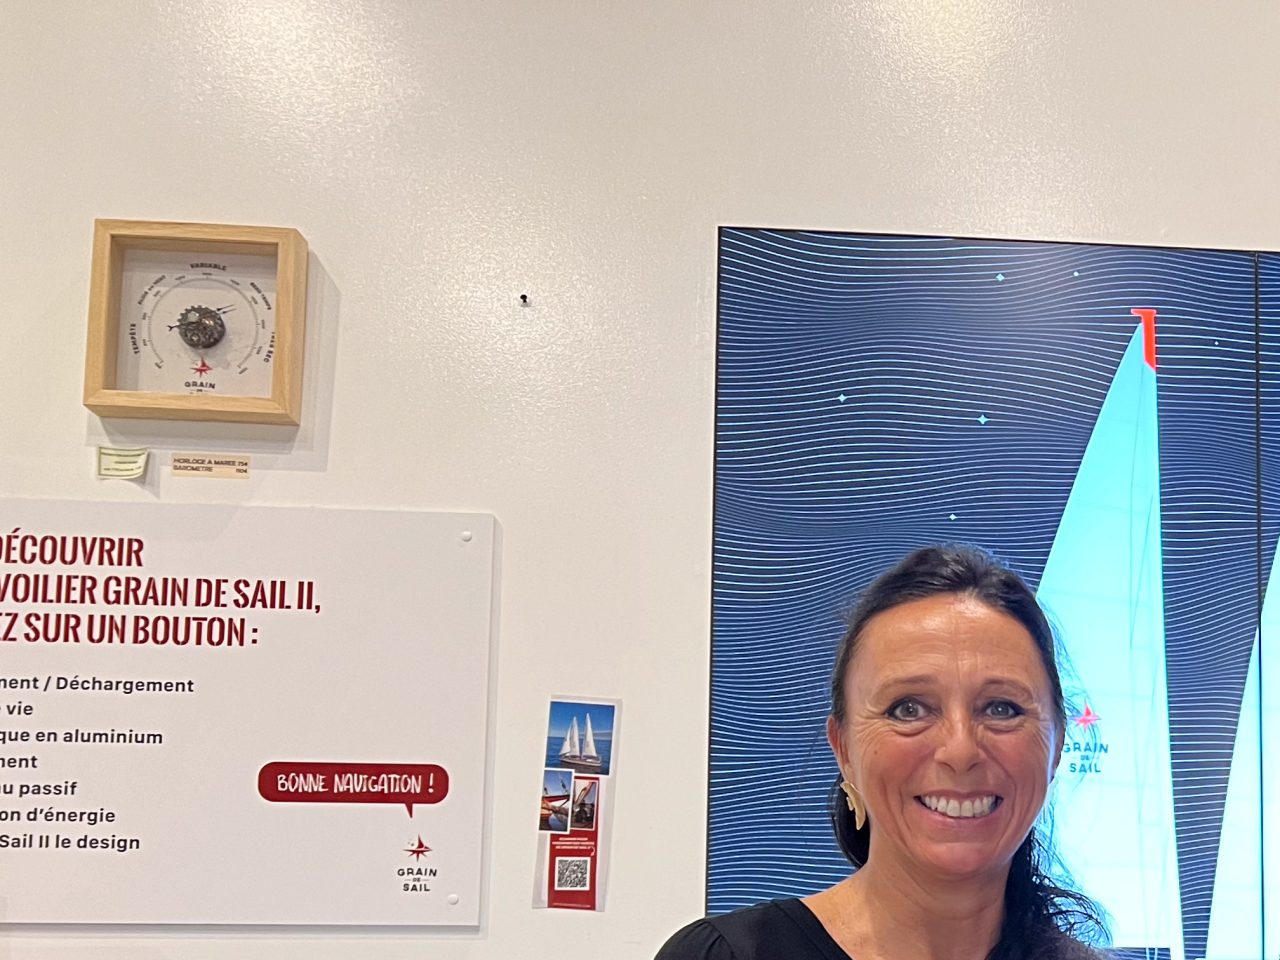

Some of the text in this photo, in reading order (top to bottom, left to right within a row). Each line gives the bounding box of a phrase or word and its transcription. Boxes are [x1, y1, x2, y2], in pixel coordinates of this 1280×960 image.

[103, 575, 189, 607] GRAIN
[195, 578, 228, 608] DE
[233, 579, 292, 609] SAIL
[0, 612, 18, 642] Z
[24, 612, 81, 643] SUR
[87, 614, 126, 644] UN
[132, 615, 245, 647] BOUTON
[43, 676, 52, 692] /
[56, 676, 195, 694] Déchargement
[6, 701, 34, 716] vie
[35, 731, 58, 743] en
[63, 729, 163, 745] aluminium
[1063, 742, 1109, 754] GRAIN
[1069, 762, 1102, 773] SAIL
[19, 781, 78, 798] passif
[277, 772, 329, 792] BONNE
[333, 773, 422, 793] NAVIGATION
[26, 807, 116, 826] d'énergie
[0, 834, 33, 848] Sail
[55, 834, 71, 849] le
[76, 835, 140, 853] design
[397, 867, 438, 877] GRAIN
[403, 883, 430, 892] SAIL
